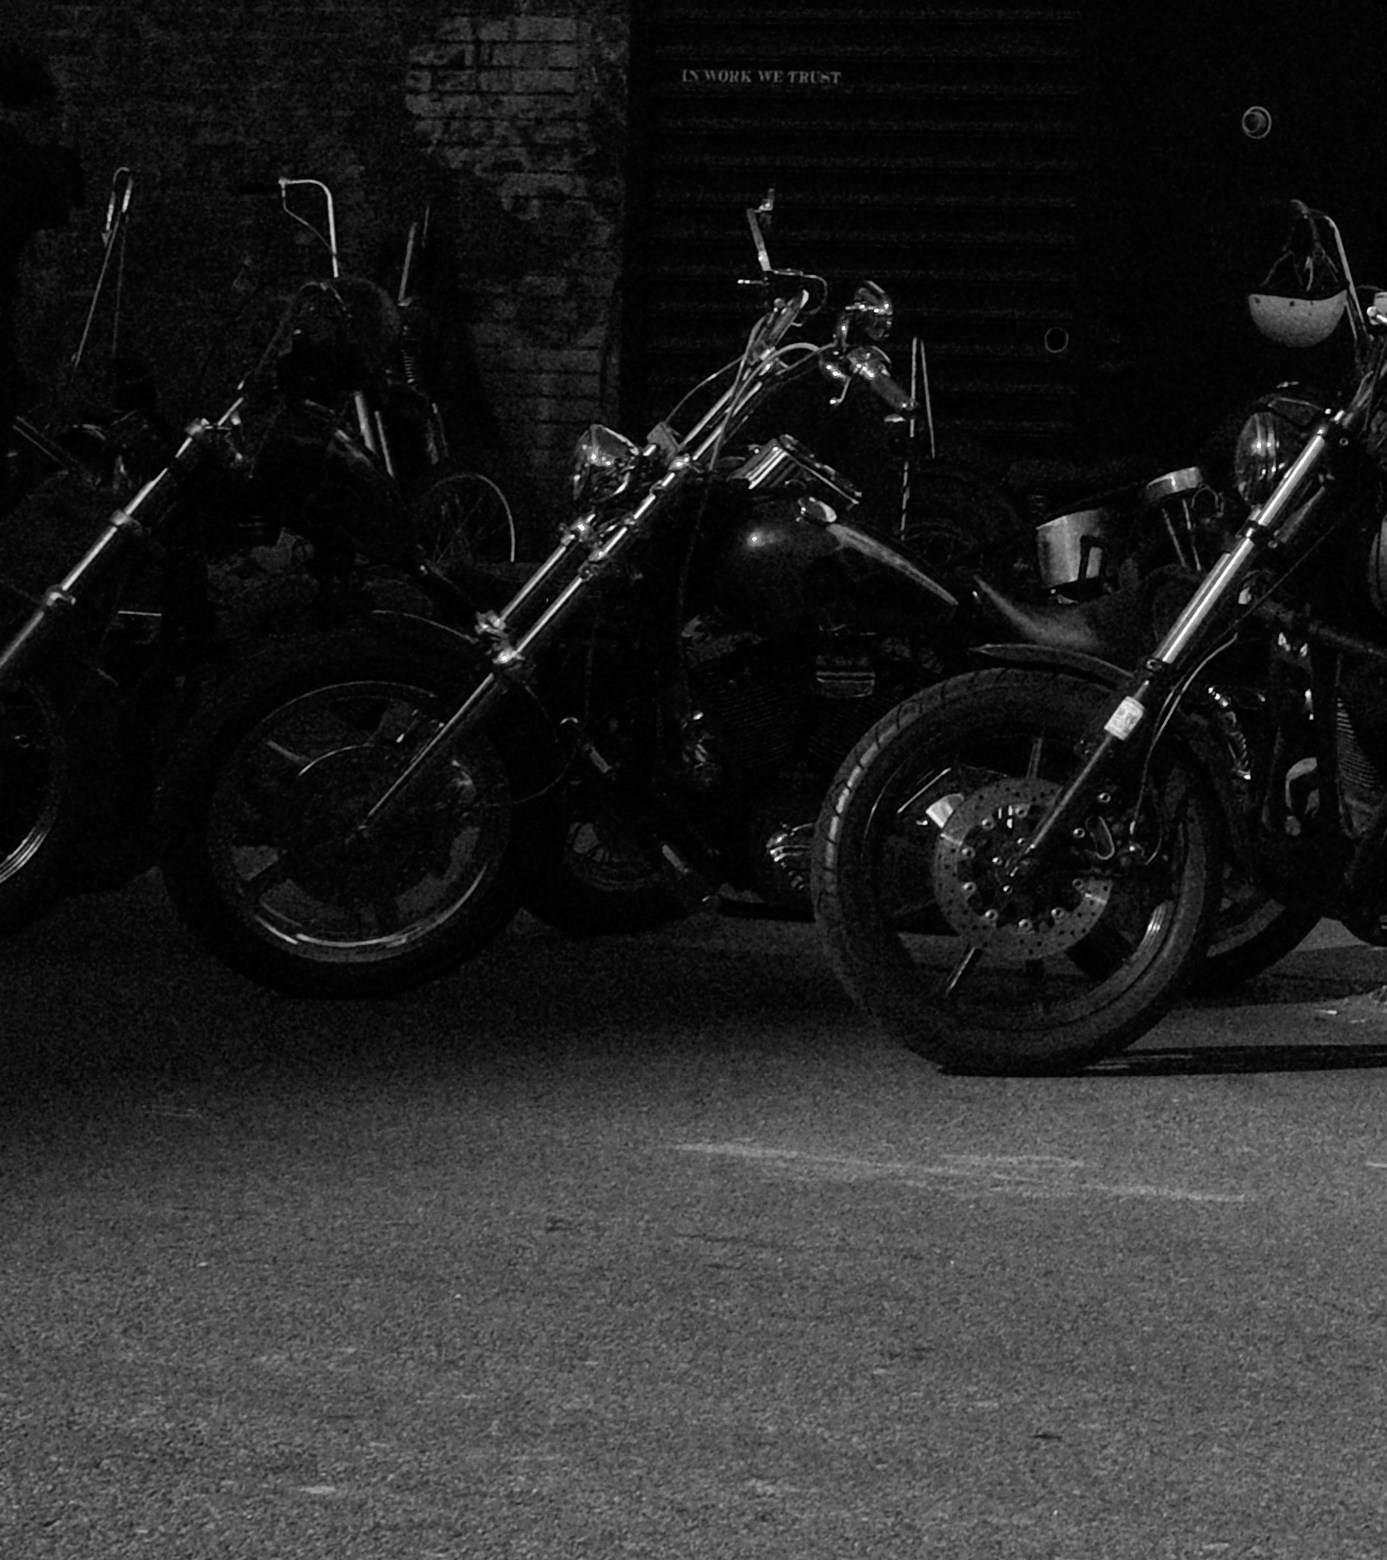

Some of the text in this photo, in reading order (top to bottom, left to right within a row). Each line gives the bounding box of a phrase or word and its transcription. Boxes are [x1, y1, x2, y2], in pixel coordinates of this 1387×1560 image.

[681, 68, 842, 85] IN WORK WE TRUST
